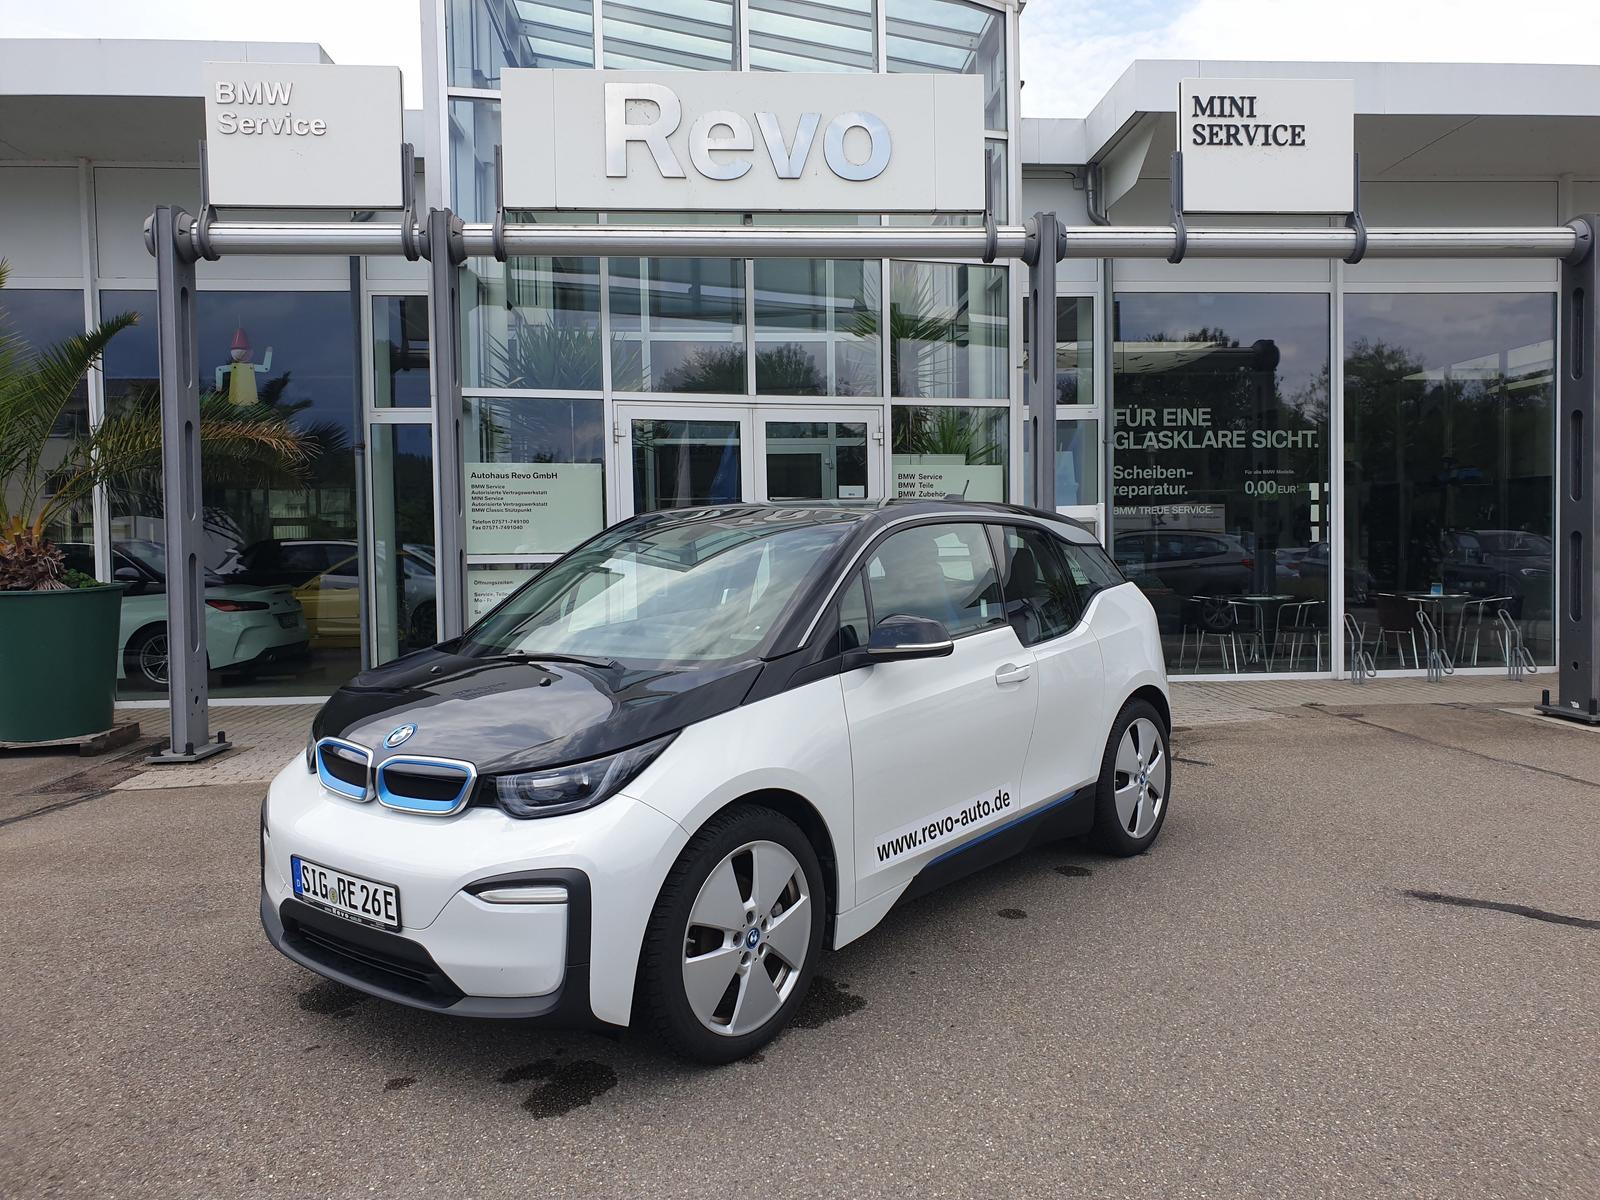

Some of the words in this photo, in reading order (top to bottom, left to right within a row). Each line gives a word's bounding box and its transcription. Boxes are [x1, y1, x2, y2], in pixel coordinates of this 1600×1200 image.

[215, 80, 294, 106] BMW
[1191, 95, 1257, 119] MINI
[216, 111, 328, 137] Service
[603, 81, 893, 182] Revo
[1191, 123, 1306, 147] SERVICE
[1113, 404, 1157, 427] FÜR
[1163, 407, 1212, 427] EINE
[1113, 429, 1246, 450] GLASKLARE
[1251, 429, 1319, 449] SICHT.
[470, 471, 510, 480] Autohaus
[511, 472, 531, 480] Revo
[532, 472, 558, 480] GmbH
[1113, 465, 1194, 480] Scheiben-
[897, 481, 916, 489] BMW
[918, 481, 934, 489] Teile
[897, 490, 916, 498] BMW
[918, 490, 946, 498] Zubehör
[1113, 482, 1188, 499] reparatur.
[1244, 480, 1277, 497] 0,00
[1113, 506, 1137, 515] BMW
[1139, 506, 1170, 515] TREUE
[876, 789, 1011, 861] www.revo-auto.de
[302, 864, 329, 900] SIG
[337, 876, 359, 911] RE
[360, 884, 396, 922] 26E
